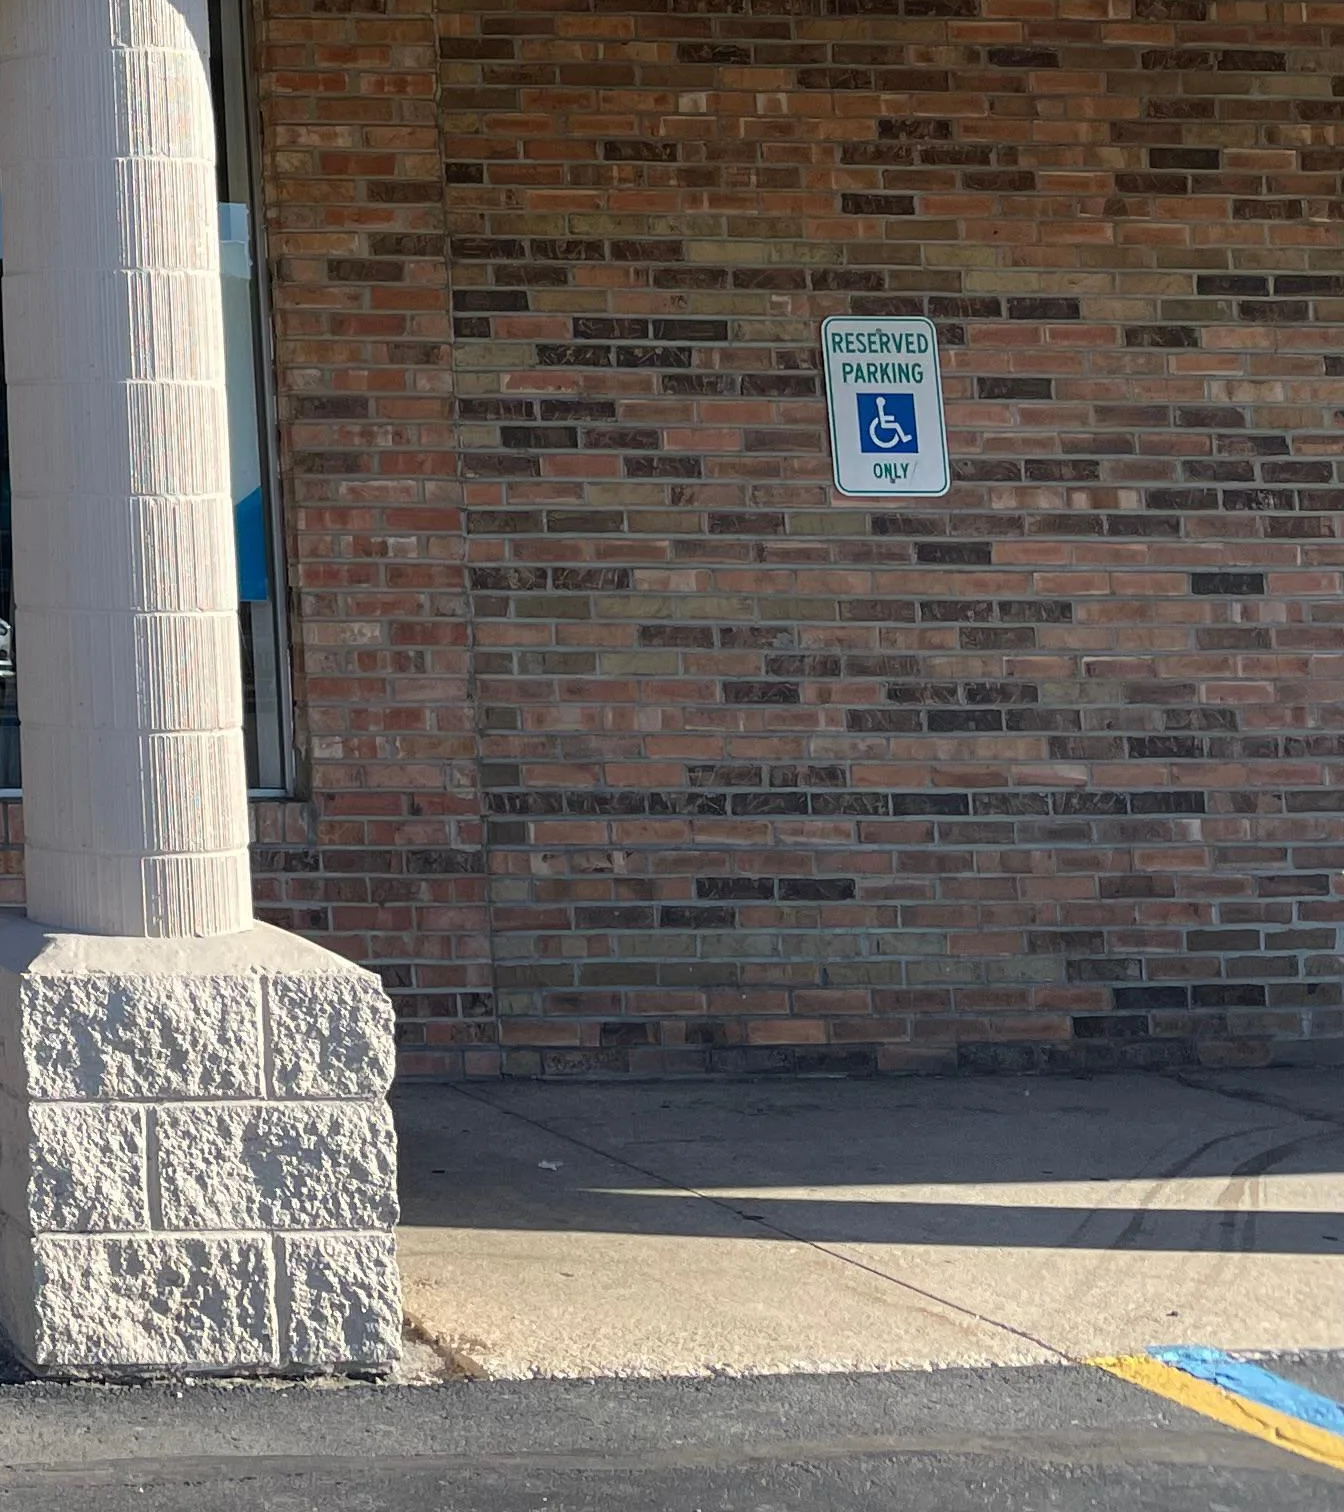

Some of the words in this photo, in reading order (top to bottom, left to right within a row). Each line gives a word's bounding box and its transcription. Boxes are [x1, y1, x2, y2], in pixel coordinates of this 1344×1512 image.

[831, 332, 929, 354] RESERVED
[842, 362, 924, 384] PARKING
[873, 463, 909, 479] ONLY
